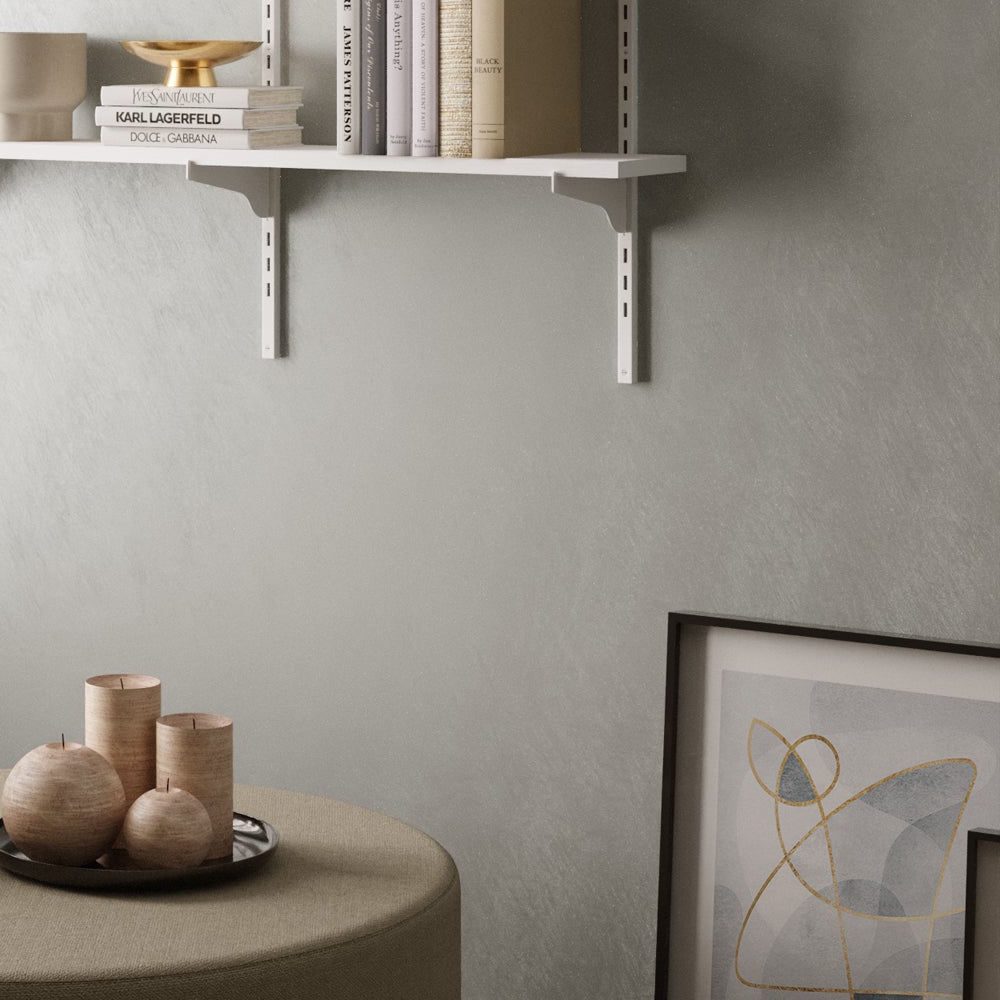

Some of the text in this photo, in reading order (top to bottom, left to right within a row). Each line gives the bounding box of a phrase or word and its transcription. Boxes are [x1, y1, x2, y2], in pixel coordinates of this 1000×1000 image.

[343, 25, 351, 66] JAMES
[392, 13, 403, 71] Anything?
[116, 111, 221, 125] KARL LAGERFELD
[343, 70, 351, 143] PATTERSON
[130, 131, 161, 142] DOLCE
[167, 132, 217, 144] GABBANA
